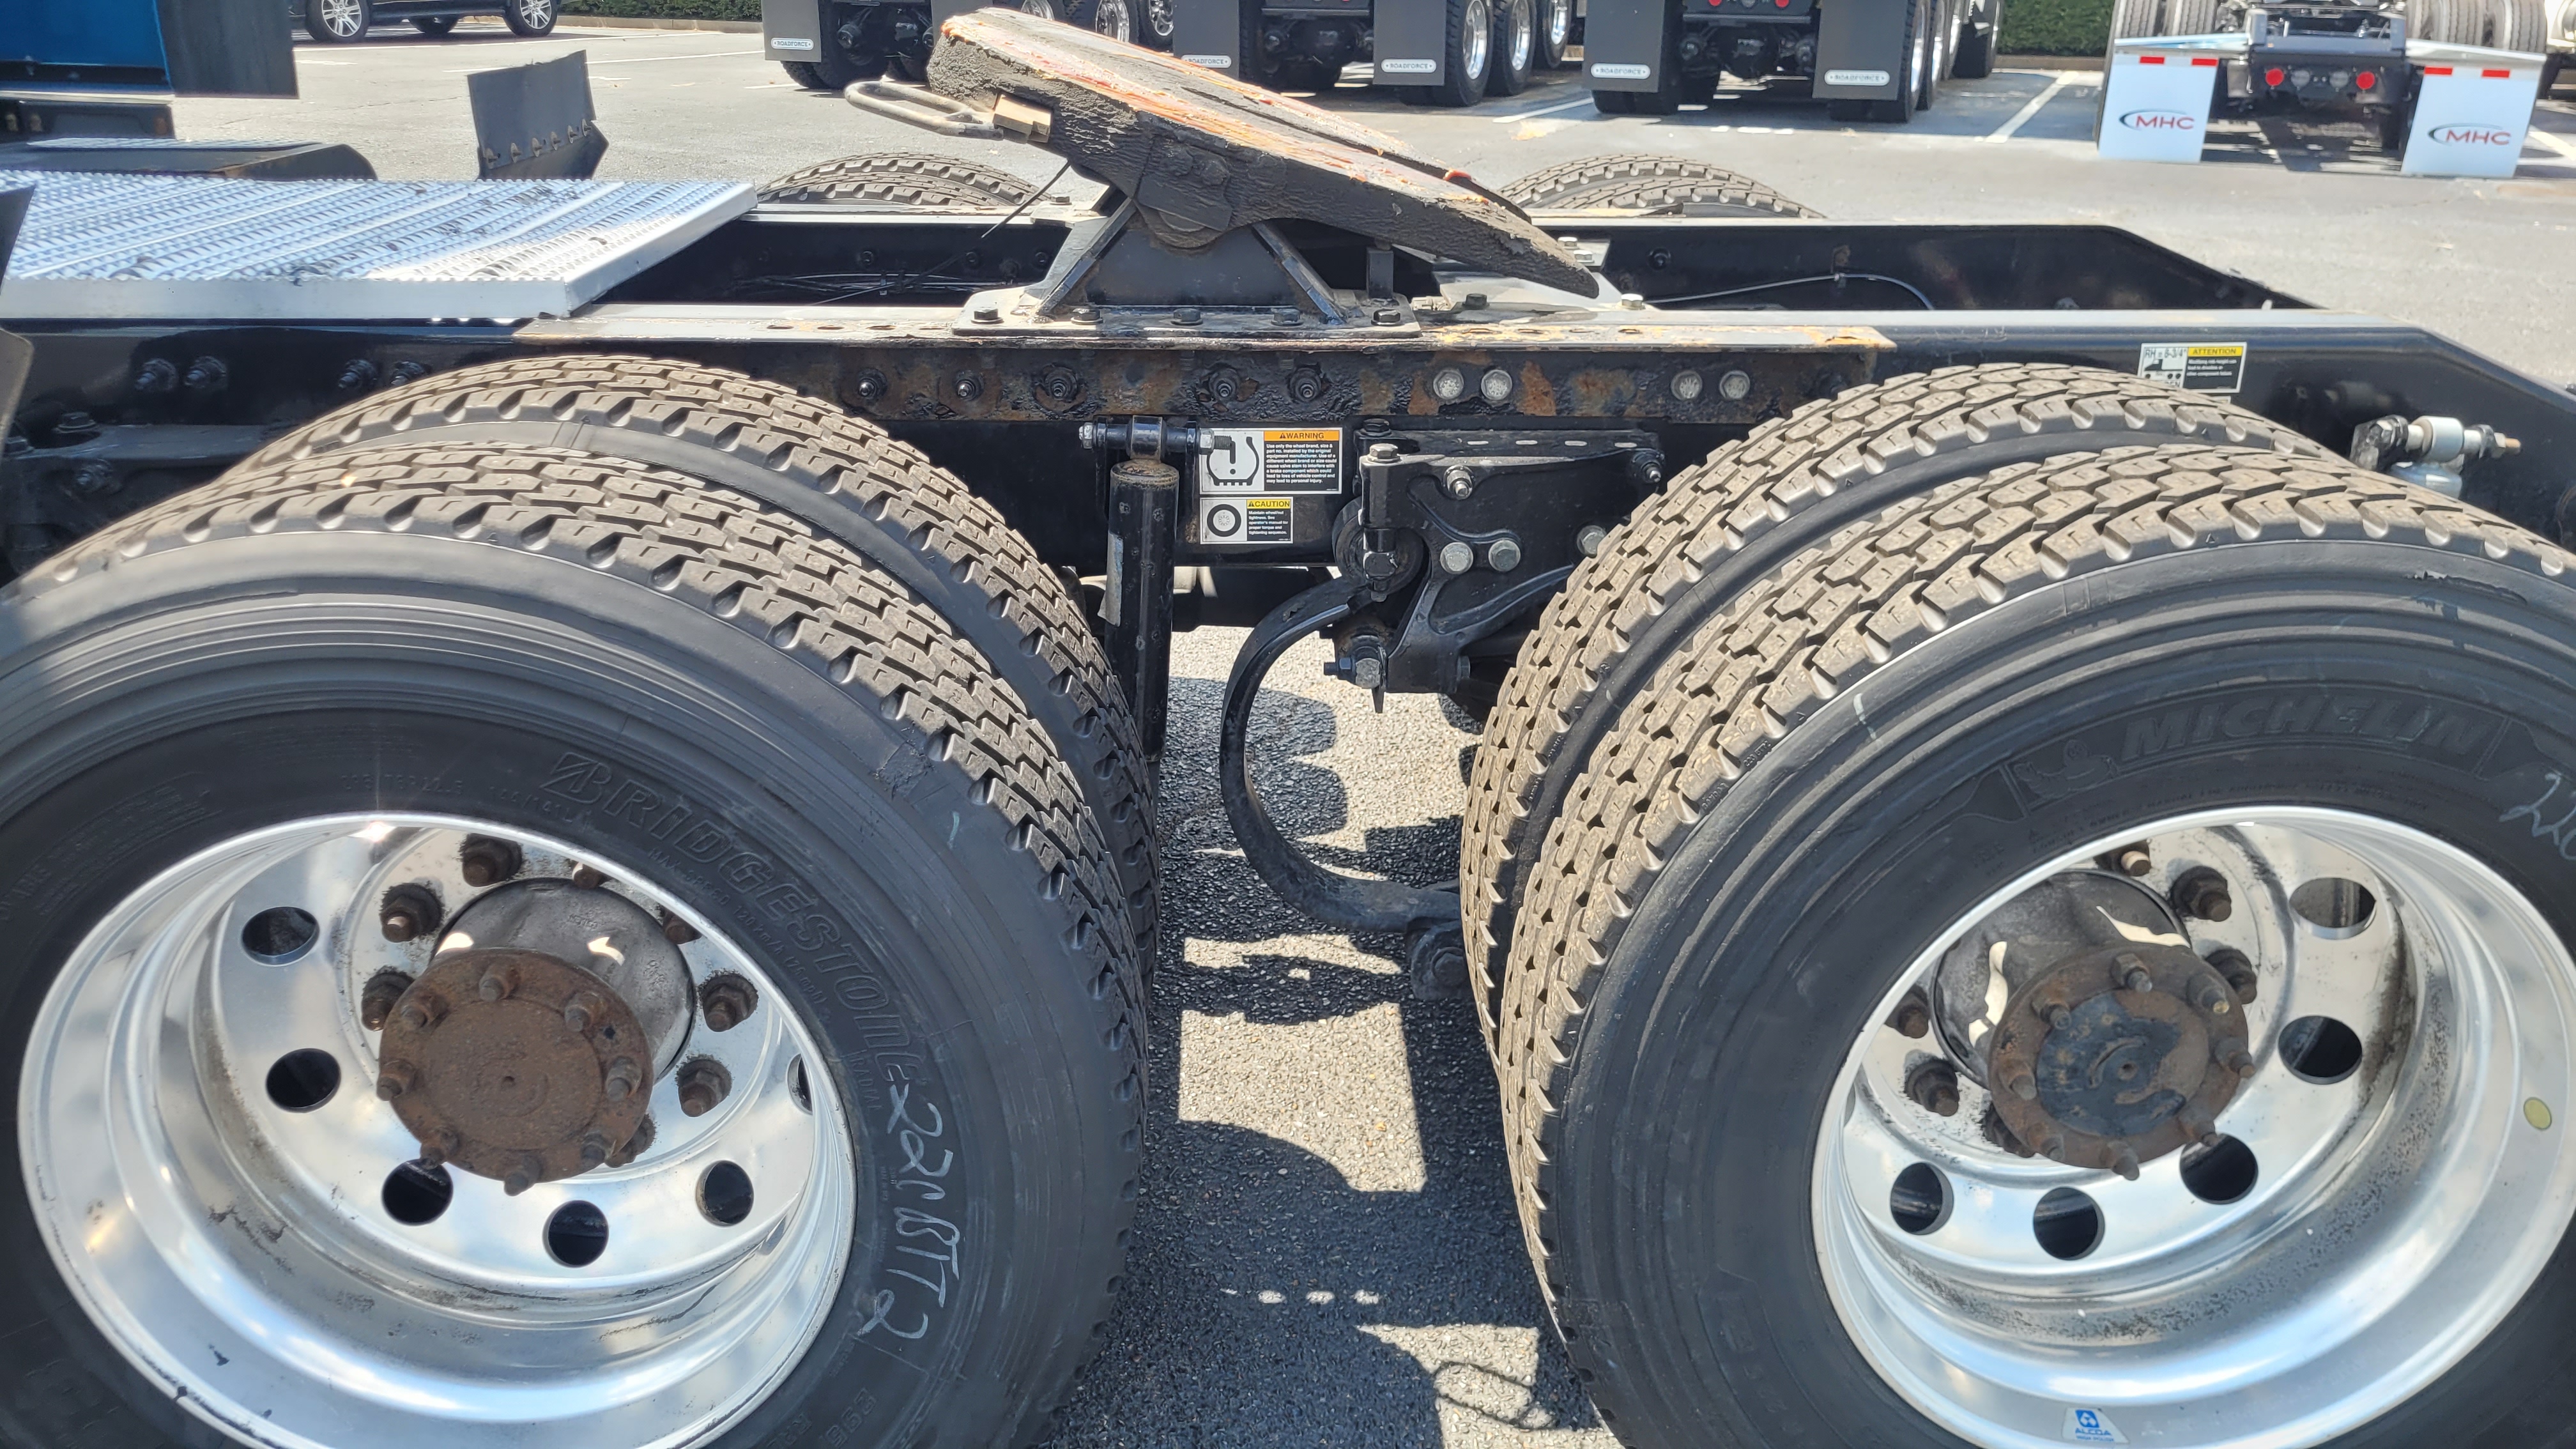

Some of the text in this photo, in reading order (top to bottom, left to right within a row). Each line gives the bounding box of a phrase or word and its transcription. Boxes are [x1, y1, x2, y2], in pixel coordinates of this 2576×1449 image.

[2136, 114, 2195, 130] MHC
[2446, 128, 2511, 145] MHC
[2122, 693, 2495, 762] MICHELIN
[539, 752, 925, 1084] BRIDGESTONE
